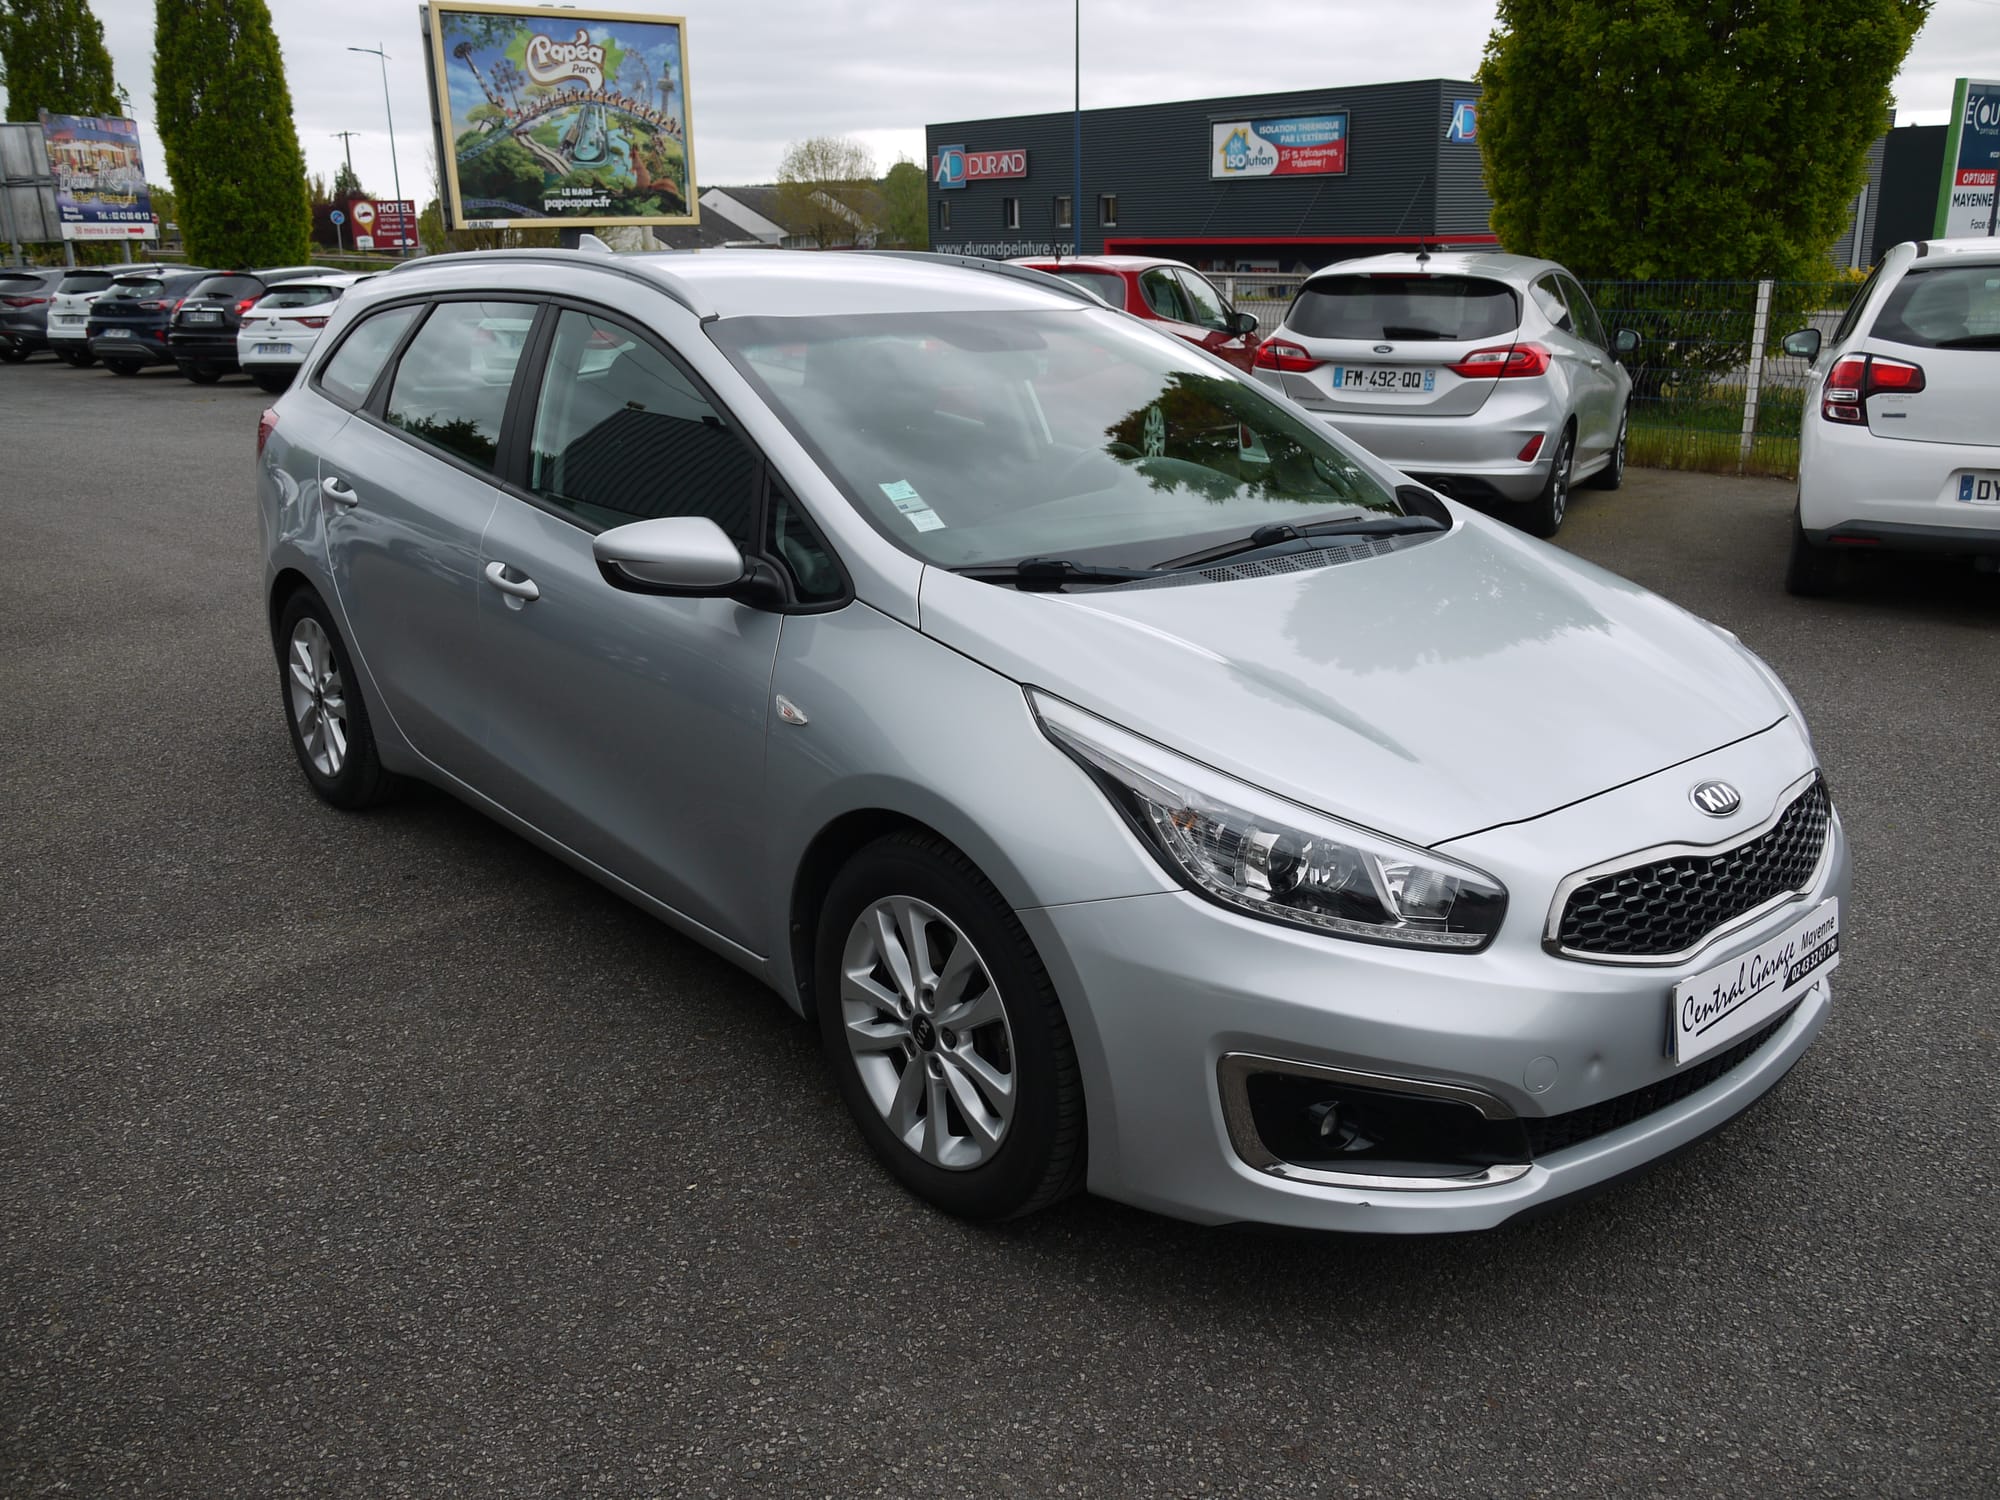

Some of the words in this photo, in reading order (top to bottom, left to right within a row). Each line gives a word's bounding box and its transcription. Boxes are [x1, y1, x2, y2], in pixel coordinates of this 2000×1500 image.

[527, 30, 604, 65] Papéa
[572, 64, 597, 74] Parc
[935, 150, 966, 183] AD
[968, 154, 1025, 175] DURAND
[1226, 150, 1274, 168] ISOlution
[1962, 173, 1995, 185] OPTIQUE
[561, 188, 571, 196] LE
[1952, 193, 1994, 207] MAYENNE
[377, 203, 413, 213] HOTEL
[544, 197, 611, 211] papeaparc.fr
[1696, 784, 1739, 811] KIA
[1801, 916, 1834, 951] Mayenne
[1682, 962, 1746, 1032] Central
[1750, 942, 1795, 990] Garage
